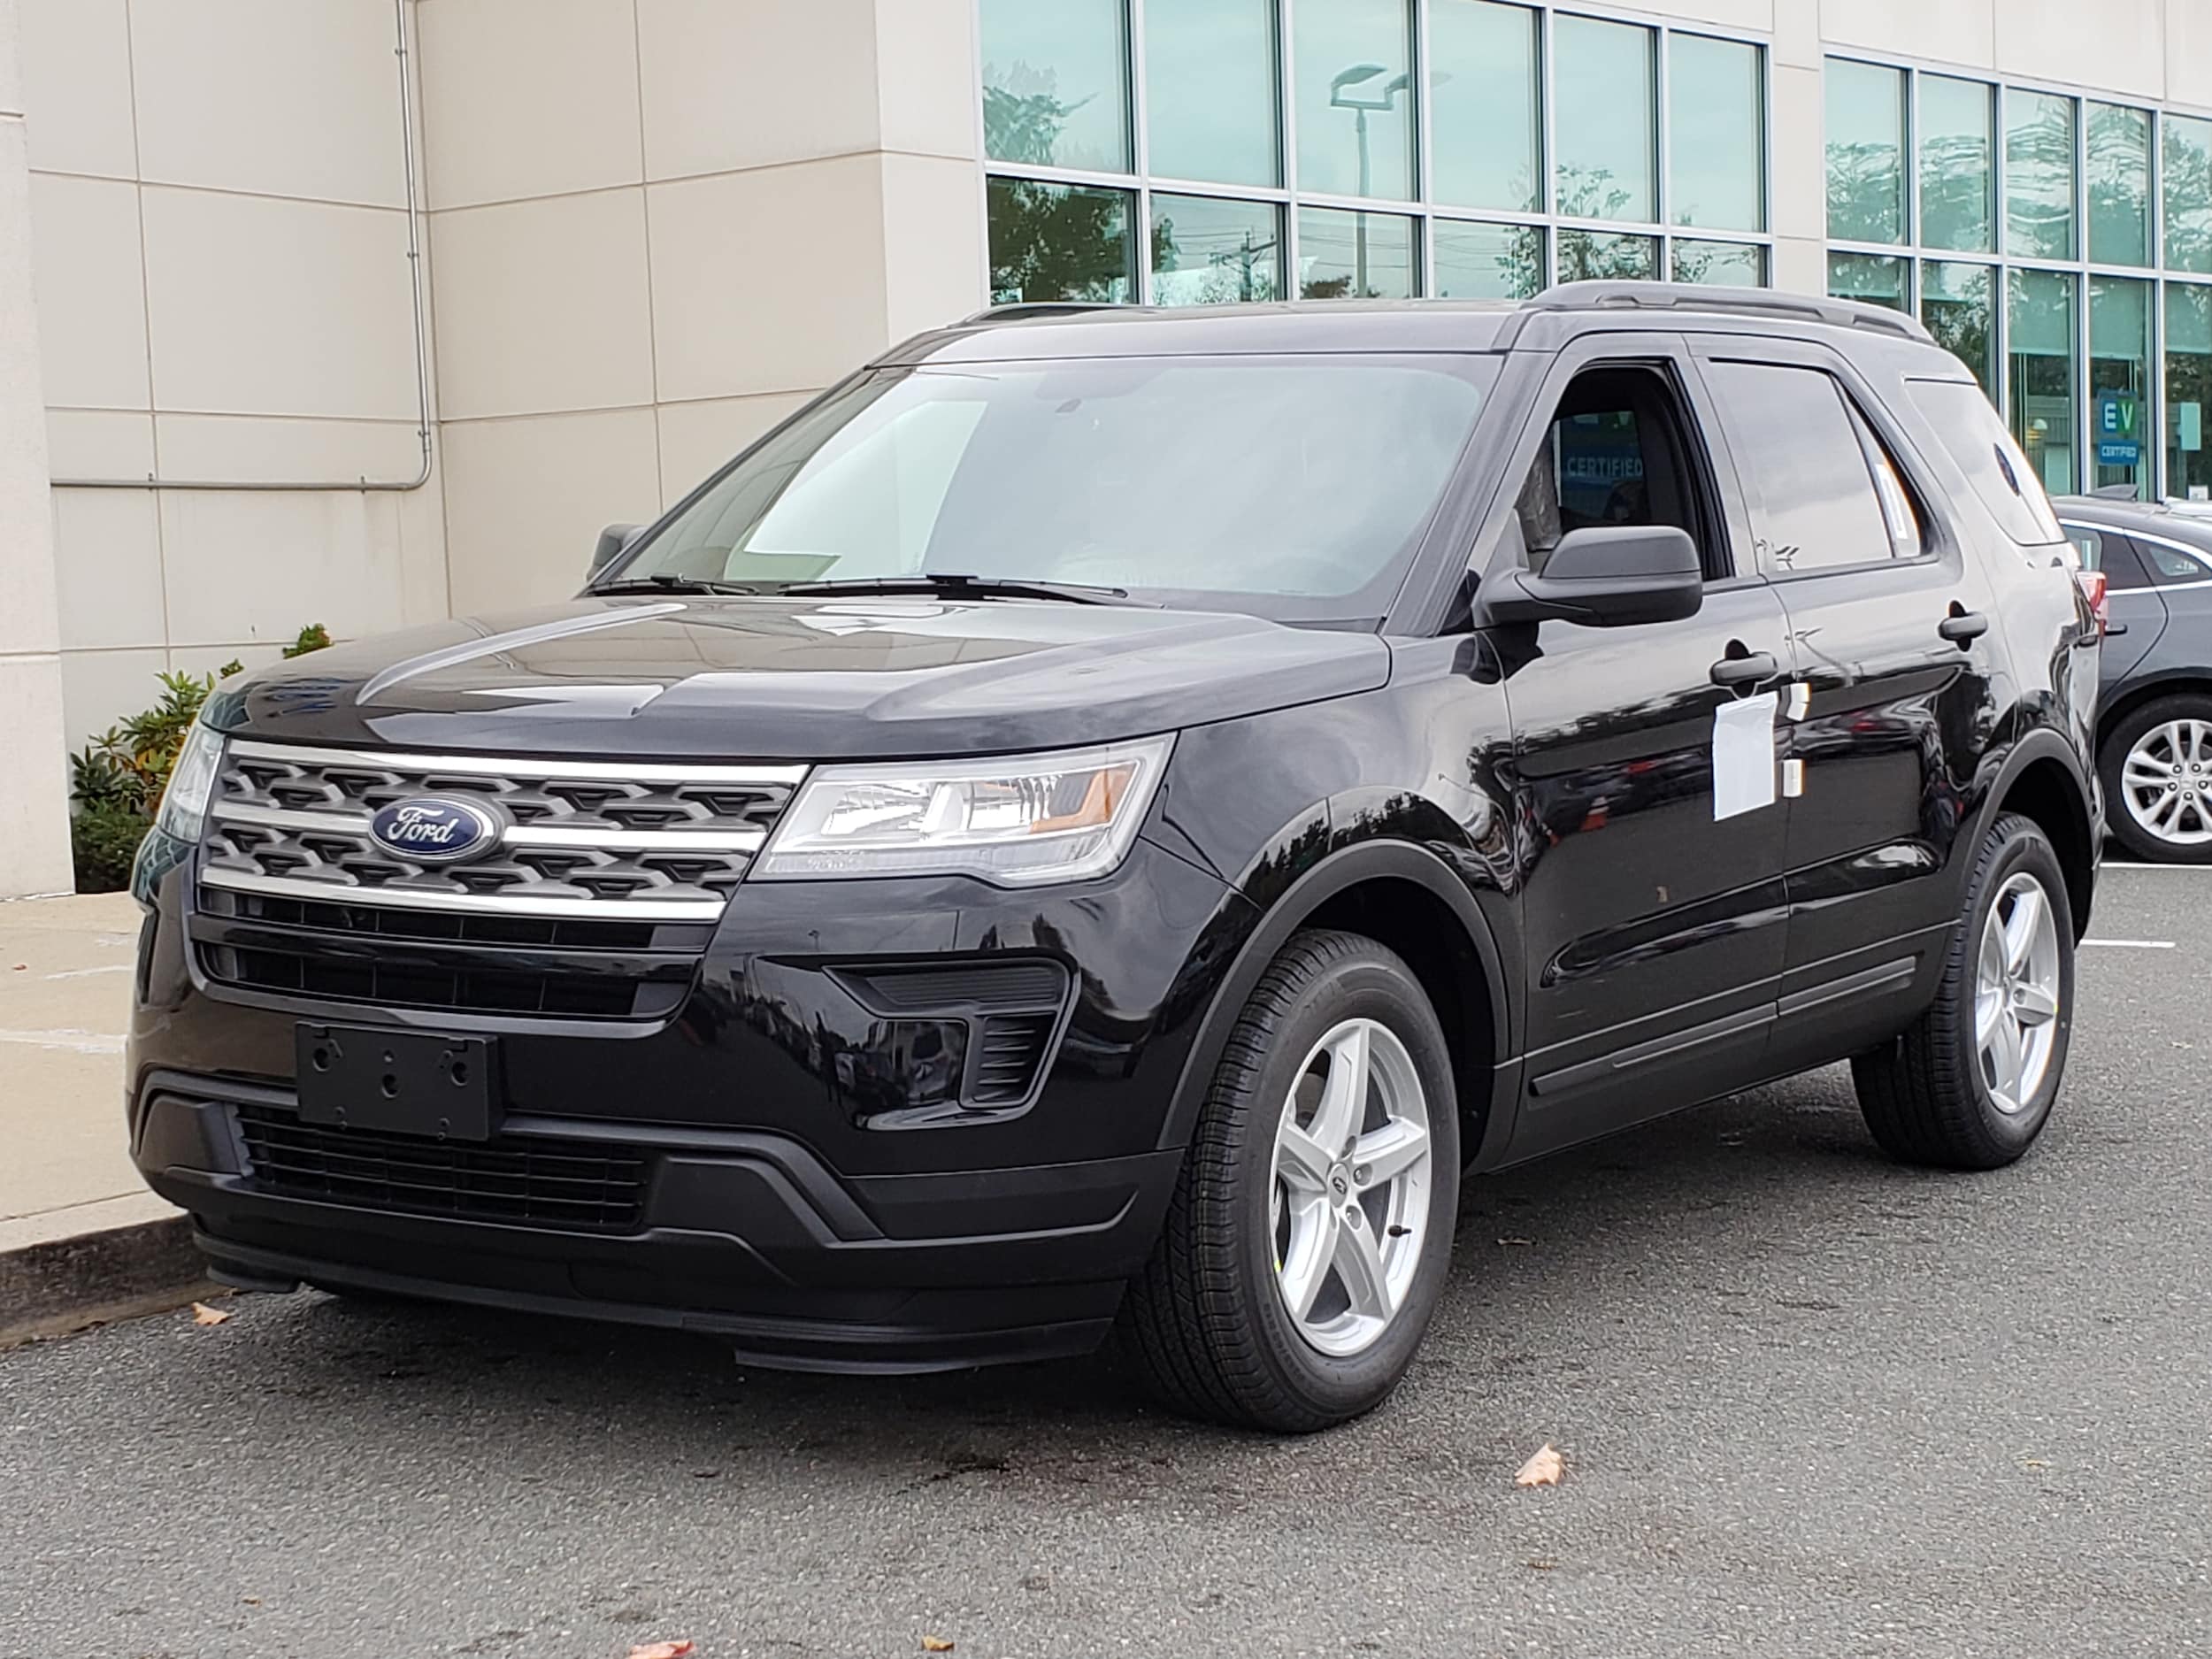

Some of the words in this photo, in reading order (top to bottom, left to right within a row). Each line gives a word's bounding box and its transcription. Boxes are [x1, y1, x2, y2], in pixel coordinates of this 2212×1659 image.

[2104, 403, 2134, 430] EV
[1566, 457, 1644, 477] CERTIFIED
[387, 806, 459, 843] Ford
